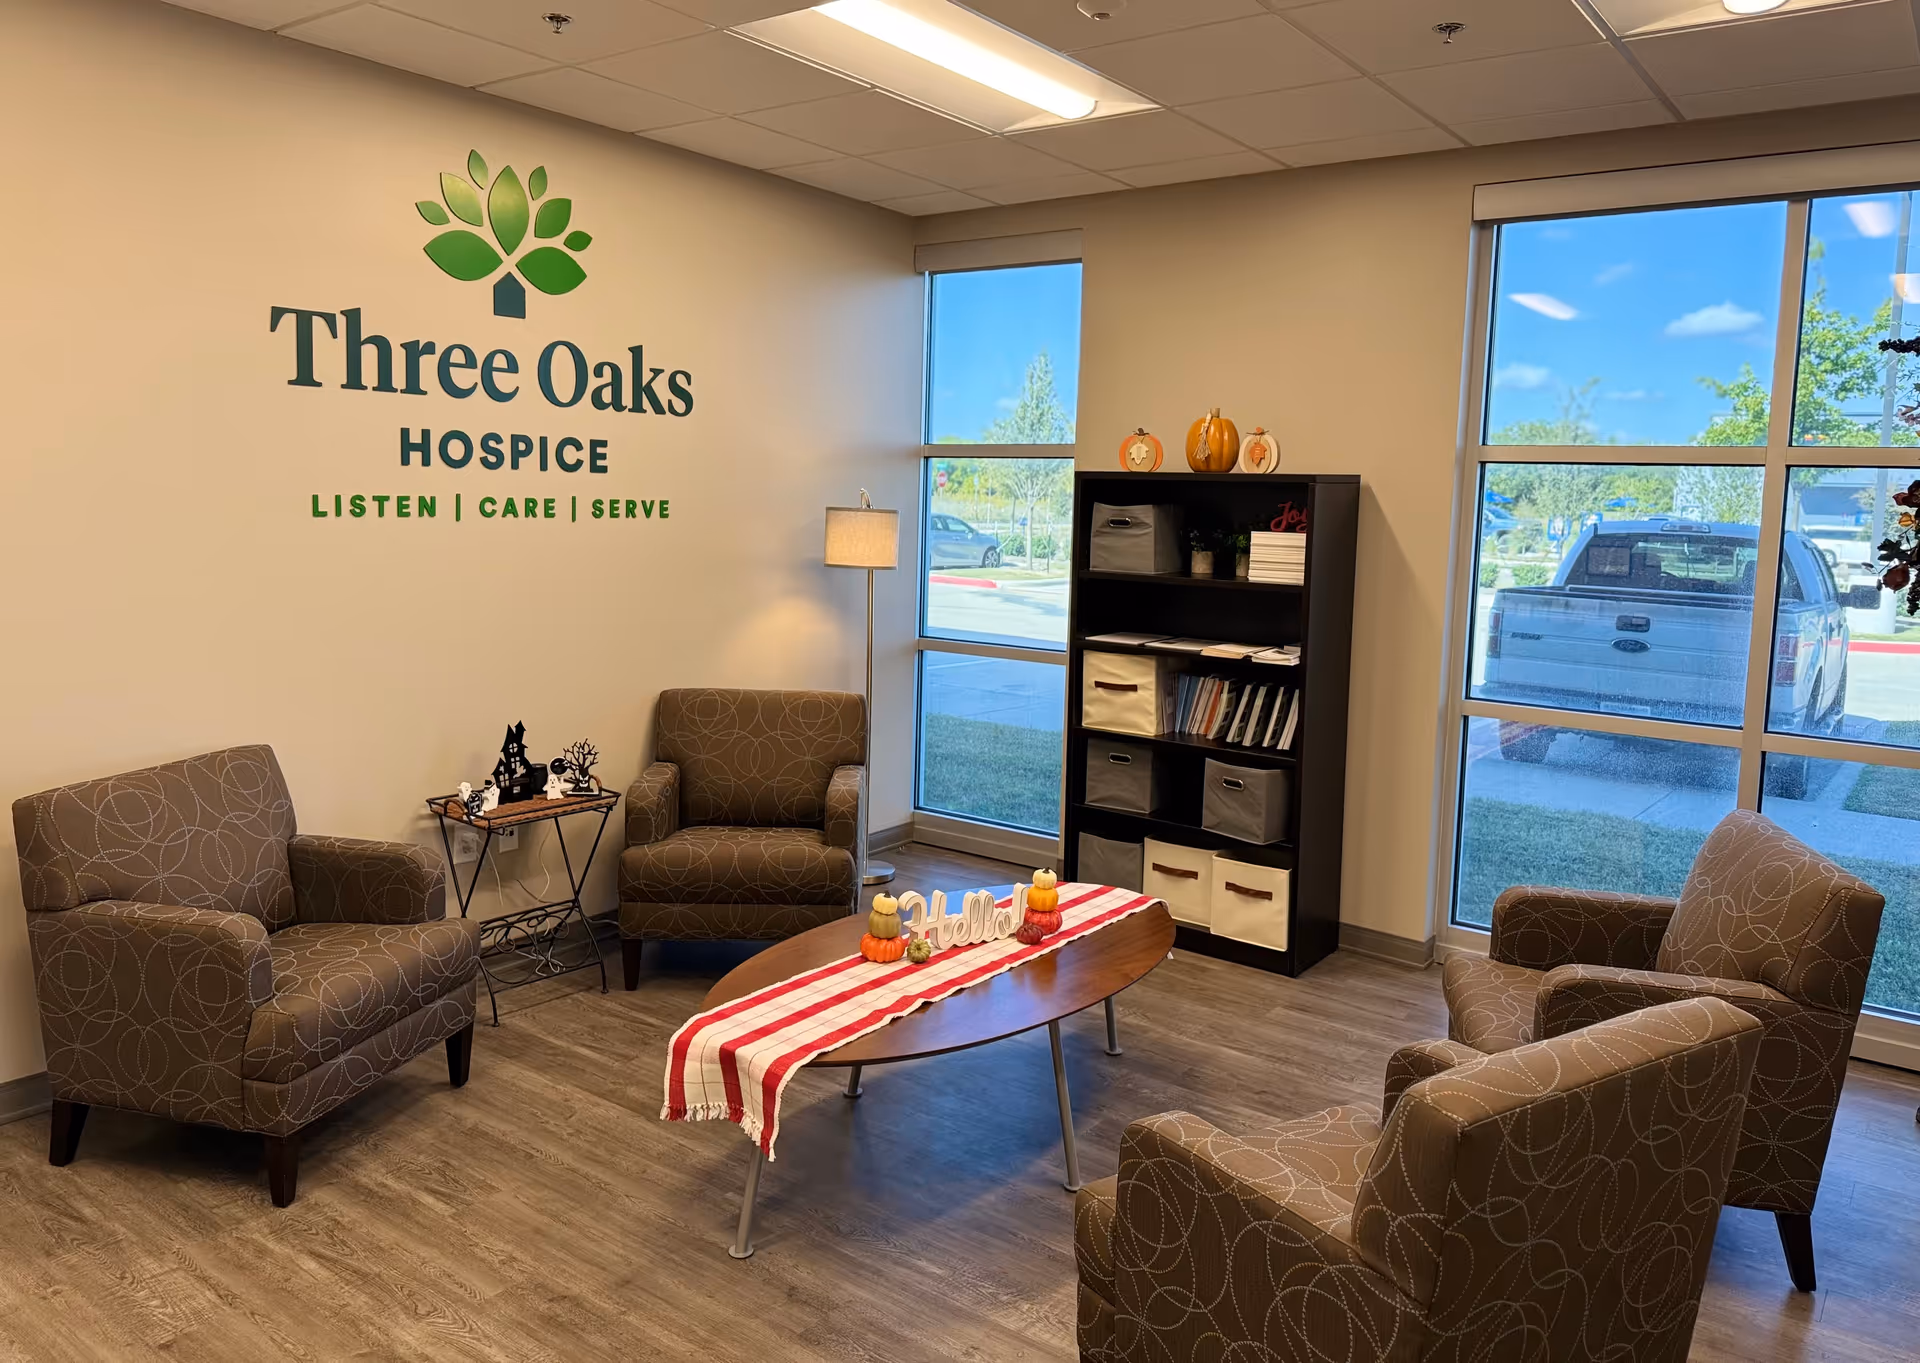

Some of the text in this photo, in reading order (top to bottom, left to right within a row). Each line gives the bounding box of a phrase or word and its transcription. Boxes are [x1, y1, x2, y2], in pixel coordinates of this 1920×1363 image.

[270, 305, 694, 417] Three Oaks
[400, 427, 608, 474] HOSPICE
[312, 494, 436, 519] LISTEN
[479, 496, 556, 519] CARE
[591, 498, 670, 519] SERVE
